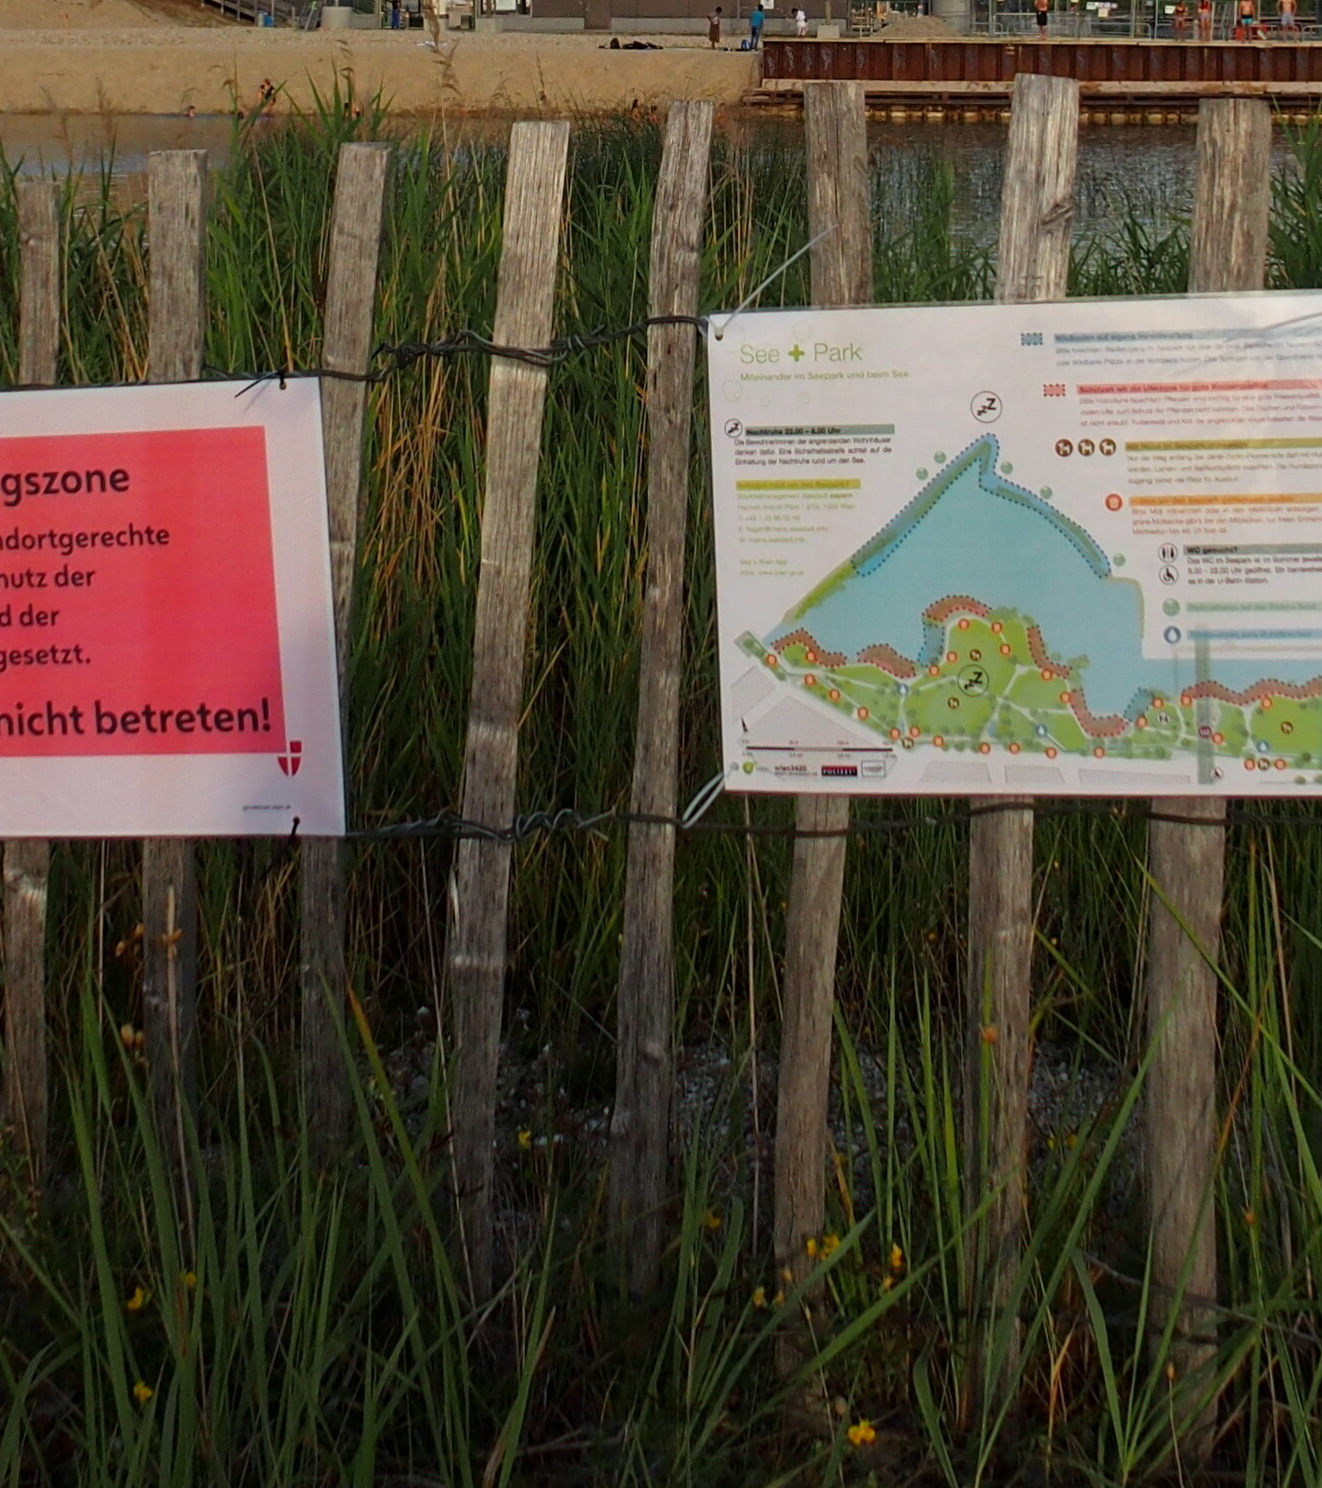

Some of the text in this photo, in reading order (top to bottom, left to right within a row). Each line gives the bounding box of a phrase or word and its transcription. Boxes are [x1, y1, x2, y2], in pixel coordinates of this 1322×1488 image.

[740, 344, 780, 364] See
[813, 342, 863, 362] Park
[54, 565, 96, 588] der
[19, 604, 60, 628] der
[95, 698, 273, 735] betreten!
